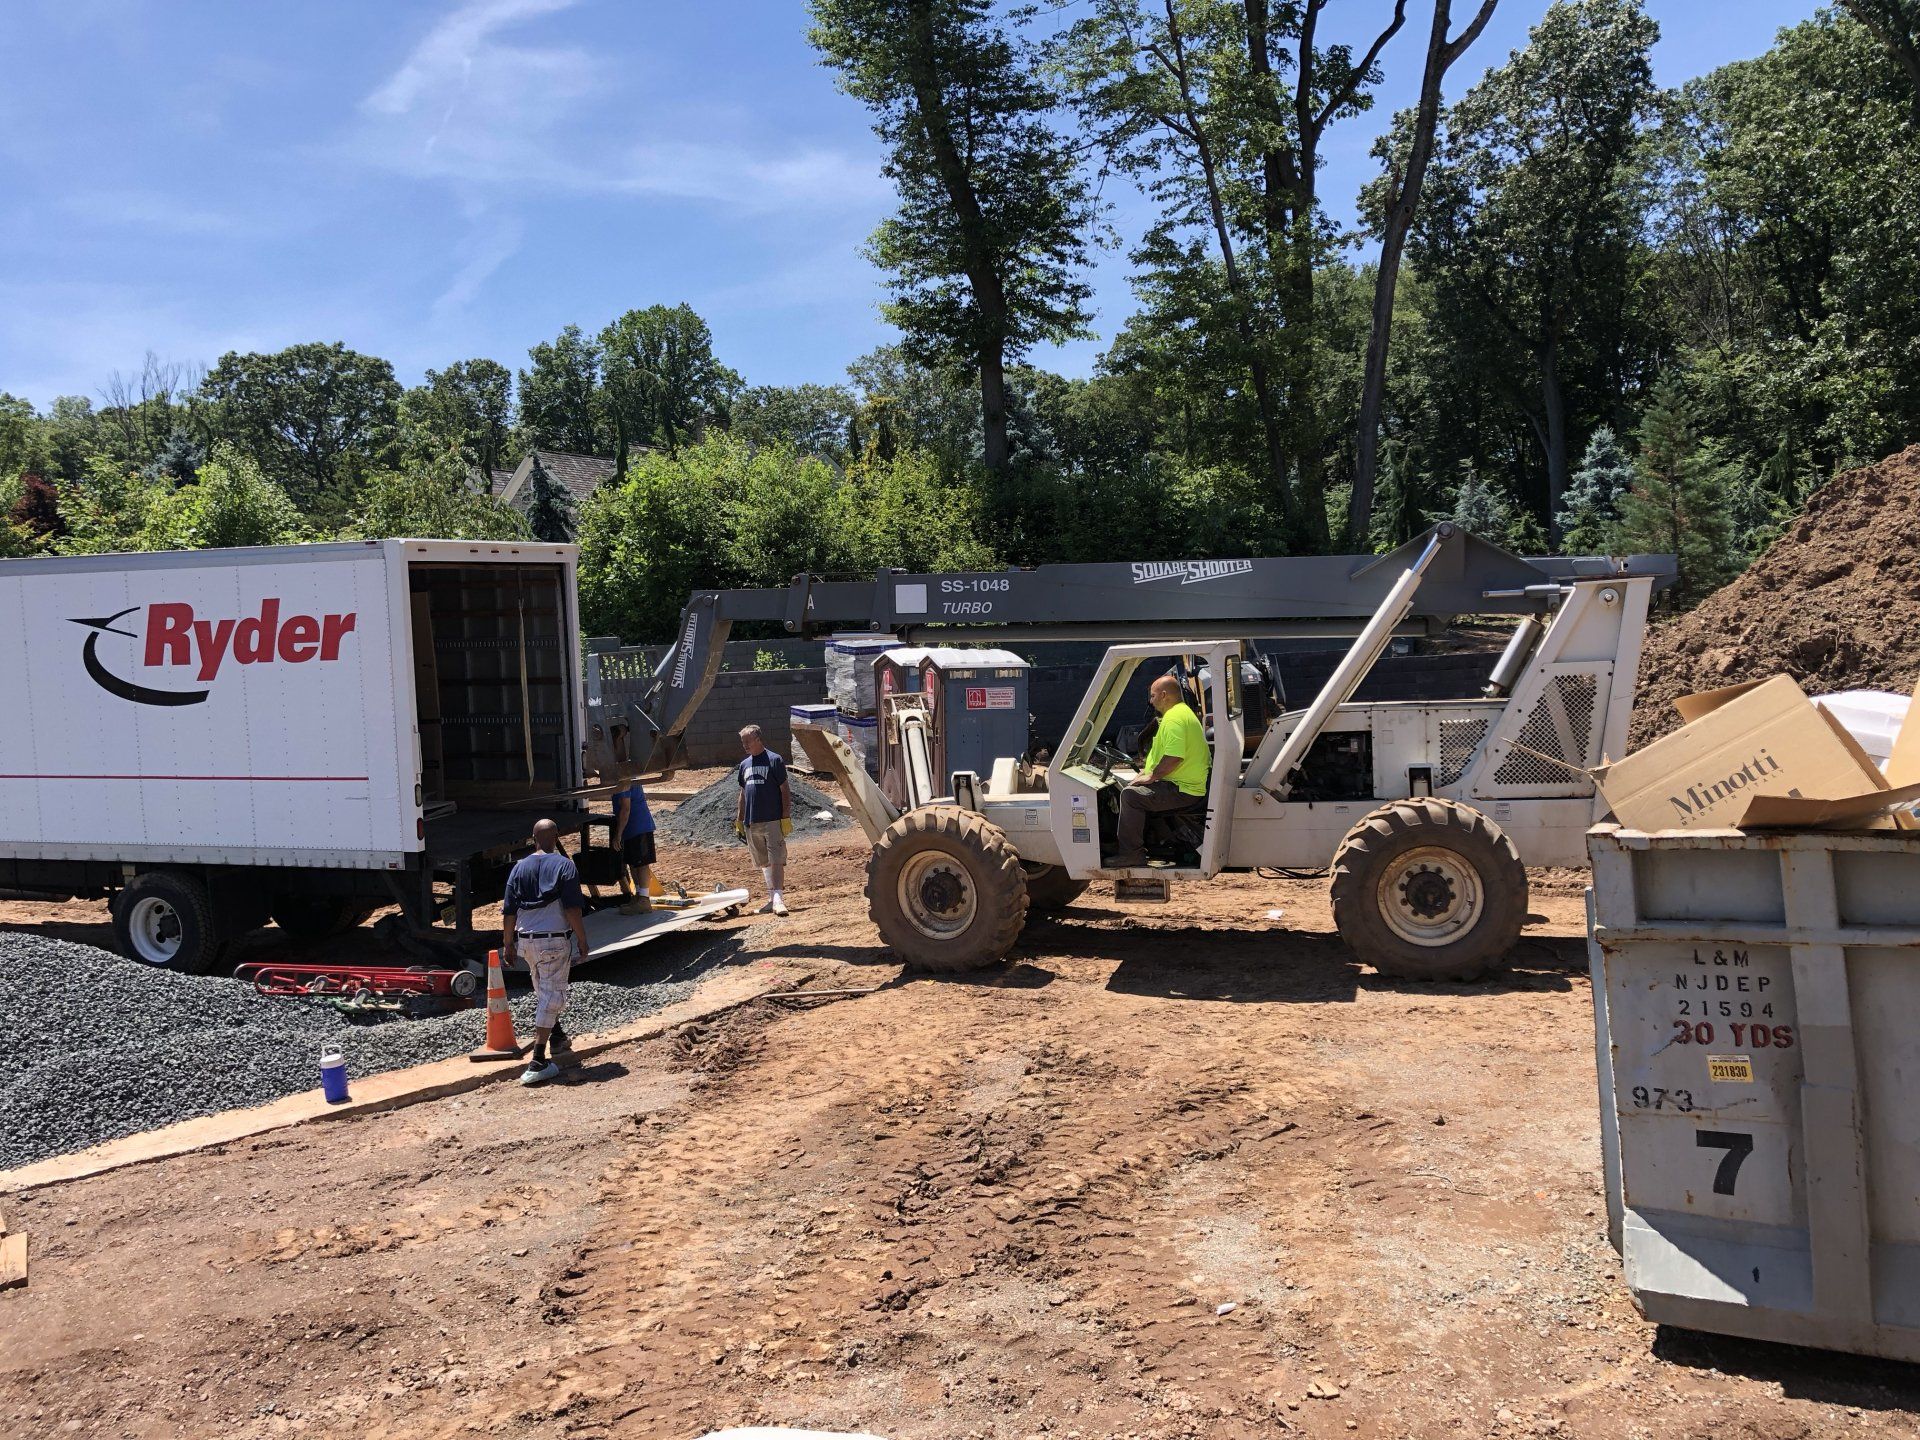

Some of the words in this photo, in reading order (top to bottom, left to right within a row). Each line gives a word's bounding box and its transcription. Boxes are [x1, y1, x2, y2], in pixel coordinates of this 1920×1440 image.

[1131, 562, 1187, 581] SQUARE
[1187, 560, 1253, 580] SHOOTER
[941, 579, 1010, 593] SS-1048
[807, 593, 815, 610] A
[942, 601, 993, 614] TURBO
[144, 598, 357, 681] Ryder
[671, 650, 686, 688] SQUARE
[681, 612, 698, 653] SHOOTER
[1667, 748, 1780, 820] Minotti
[1681, 806, 1714, 826] MADE
[1725, 794, 1737, 804] IN
[1747, 768, 1784, 792] ITALY
[1675, 974, 1771, 992] NJDEP
[1678, 1000, 1774, 1018] 21594
[1673, 1020, 1715, 1046] 30
[1729, 1022, 1794, 1048] YDS
[1712, 1065, 1748, 1078] 231830
[1632, 1086, 1694, 1113] 973
[1696, 1129, 1754, 1196] 7
